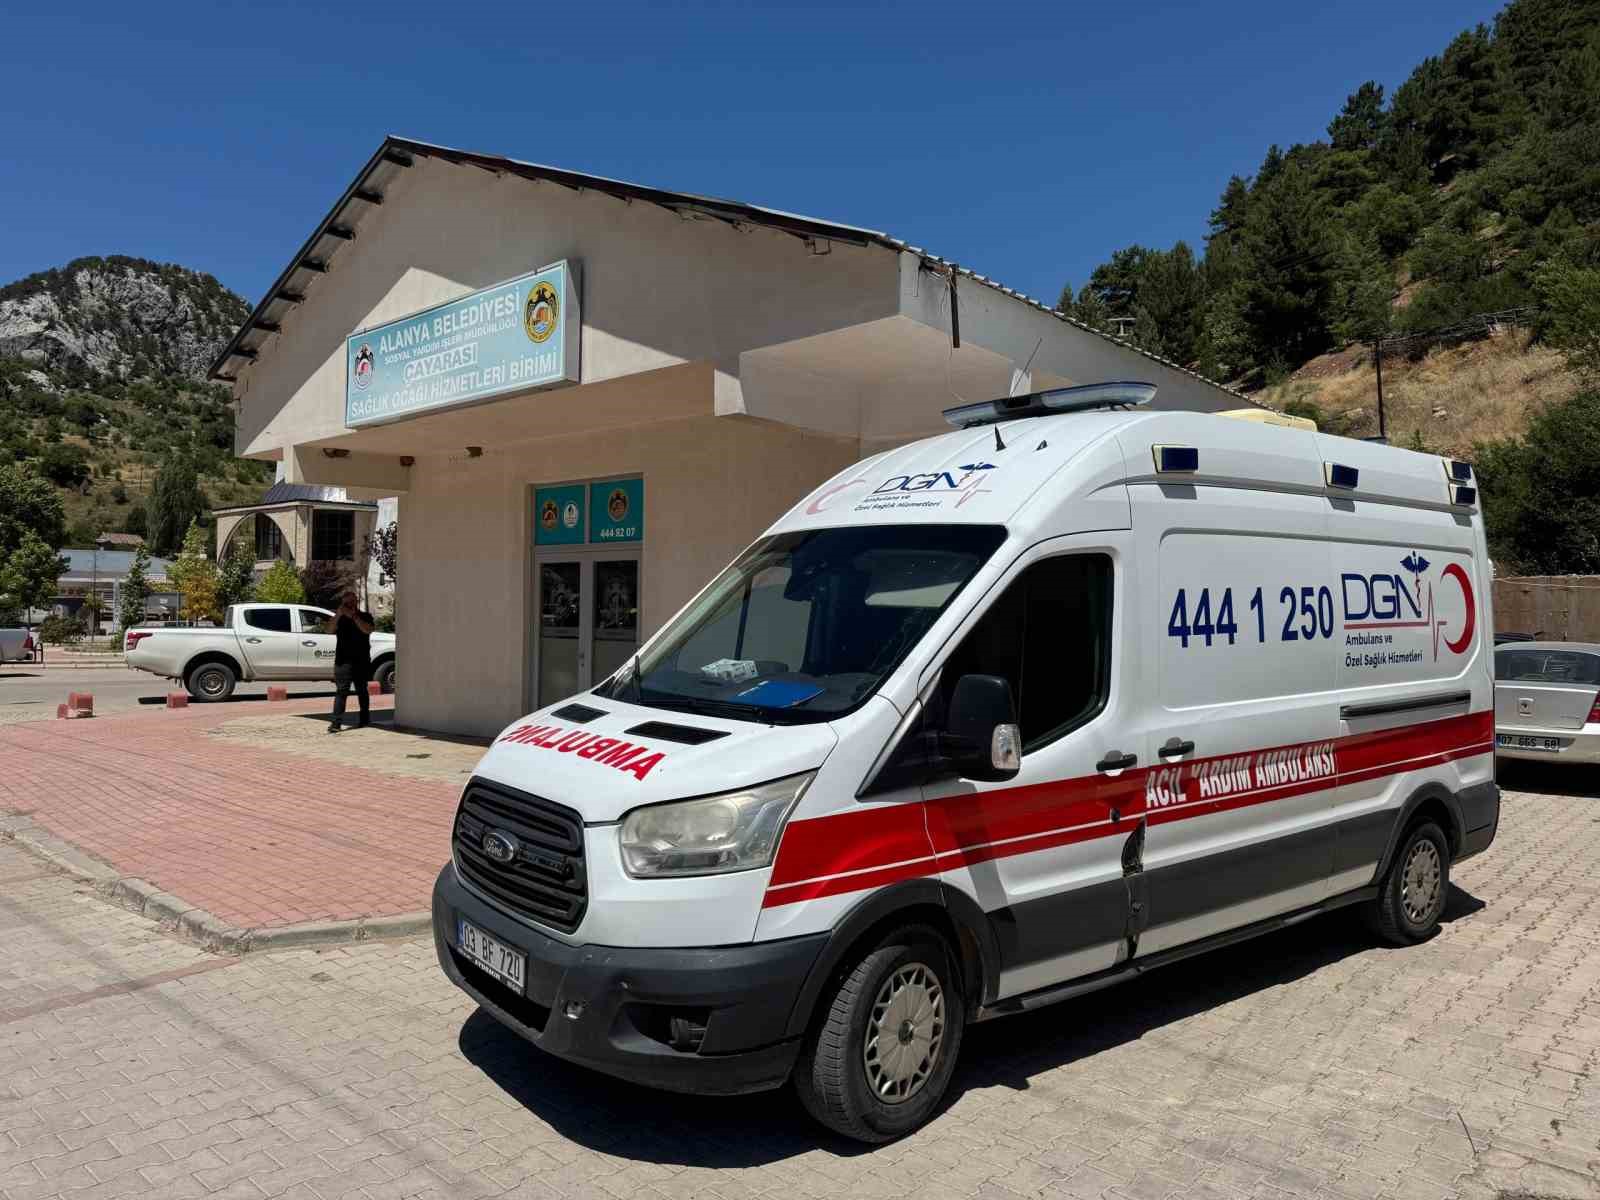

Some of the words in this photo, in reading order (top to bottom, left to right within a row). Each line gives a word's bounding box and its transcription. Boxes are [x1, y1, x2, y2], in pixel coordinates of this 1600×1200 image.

[380, 322, 430, 354] ALANYA
[433, 286, 521, 335] BELEDİYESİ
[351, 394, 390, 417] SAĞLIK
[391, 382, 428, 409] OCAĞI
[430, 360, 506, 398] HİZMETLERİ
[510, 347, 557, 380] BİRİMİ
[872, 471, 959, 494] DGN
[600, 527, 614, 538] 444
[625, 527, 636, 537] 07
[1168, 587, 1238, 648] 444
[1250, 587, 1266, 643] 1
[1280, 585, 1334, 642] 250
[1341, 573, 1422, 621] DGN
[1345, 632, 1383, 646] Ambulans
[1384, 635, 1393, 644] ve
[1345, 652, 1363, 668] Özel
[1364, 651, 1387, 668] Sağlık
[1388, 650, 1423, 664] Hizmetleri
[1145, 767, 1187, 808] ACİL
[1255, 743, 1336, 788] AMBULANSI
[463, 925, 476, 953] 03
[482, 936, 494, 963] BF
[500, 946, 520, 982] 720
